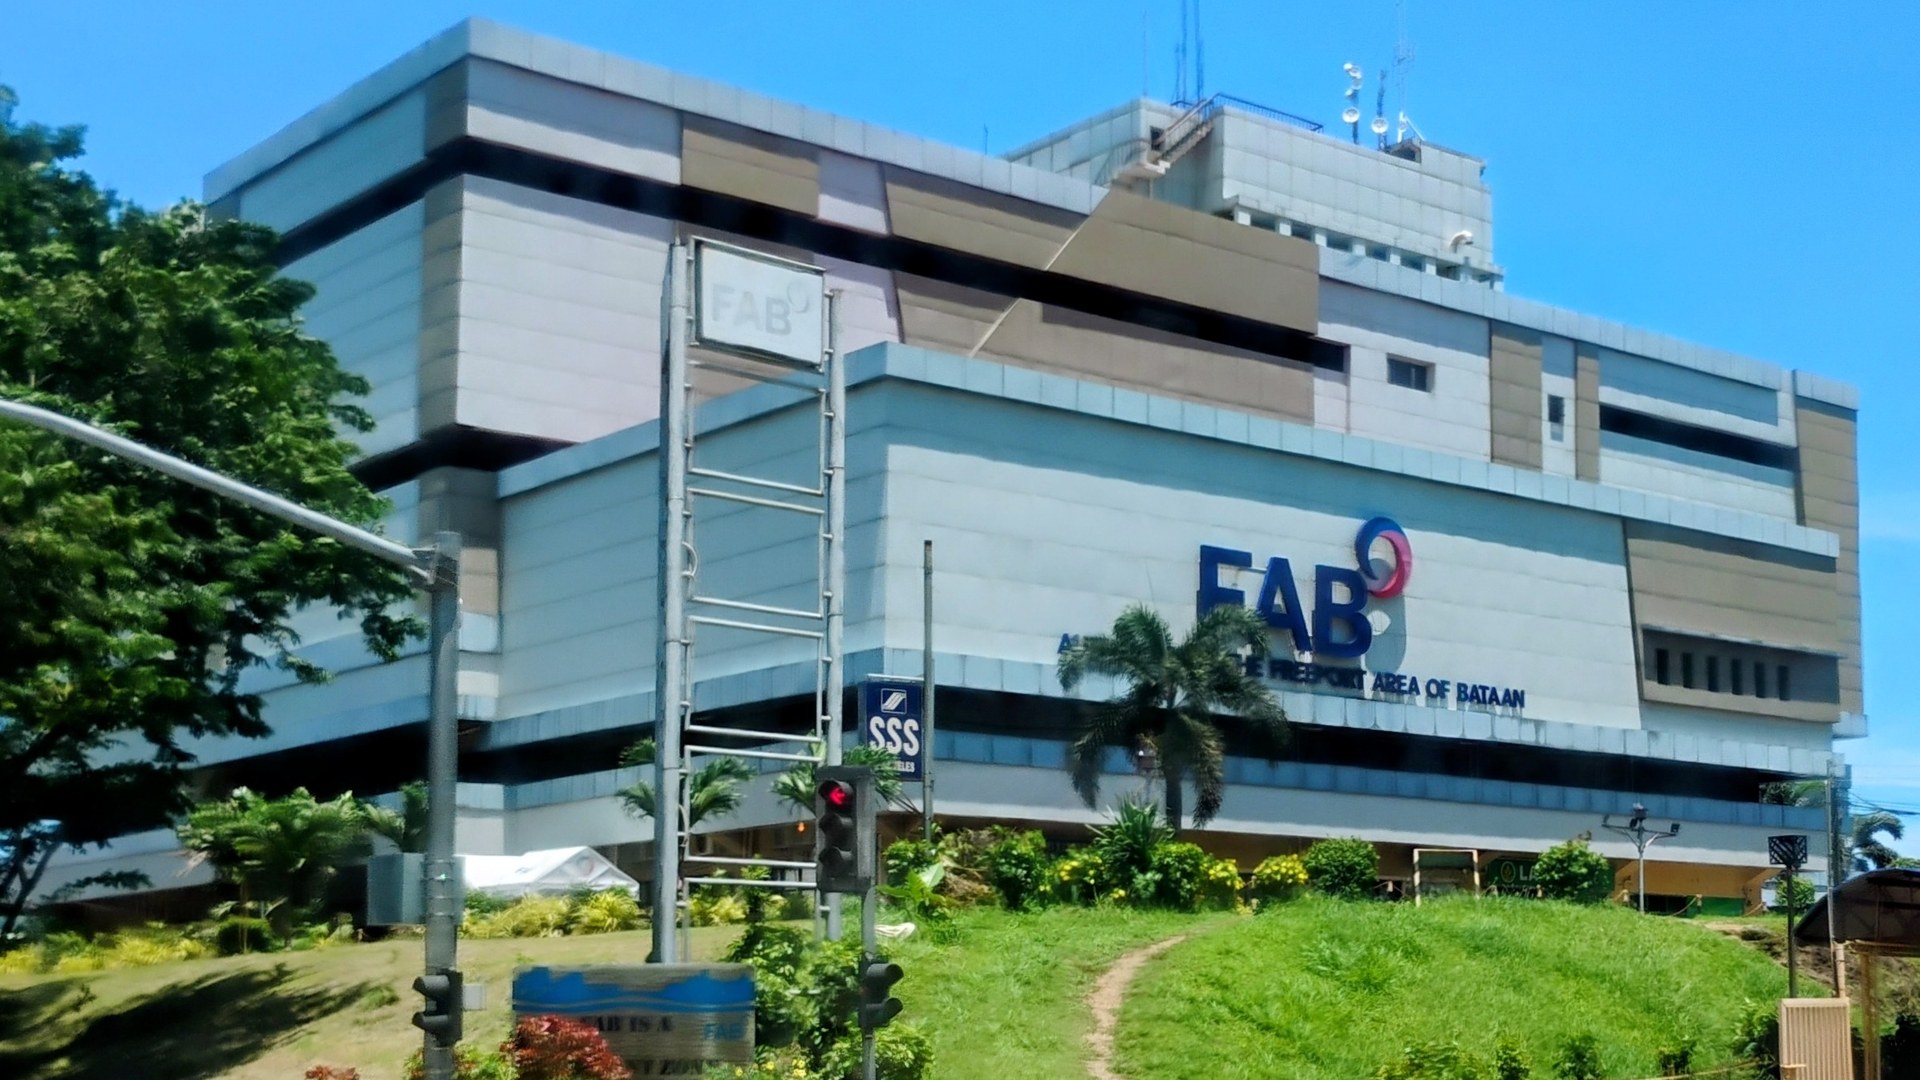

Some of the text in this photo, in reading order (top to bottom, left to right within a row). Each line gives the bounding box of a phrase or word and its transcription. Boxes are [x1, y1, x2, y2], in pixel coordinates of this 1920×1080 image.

[711, 283, 792, 336] FAB
[1197, 544, 1372, 658] FAB
[1269, 659, 1367, 690] FREEPORT
[1372, 671, 1421, 696] AREA
[1425, 678, 1450, 699] OF
[1456, 682, 1525, 708] BATAAN
[869, 715, 920, 757] SSS
